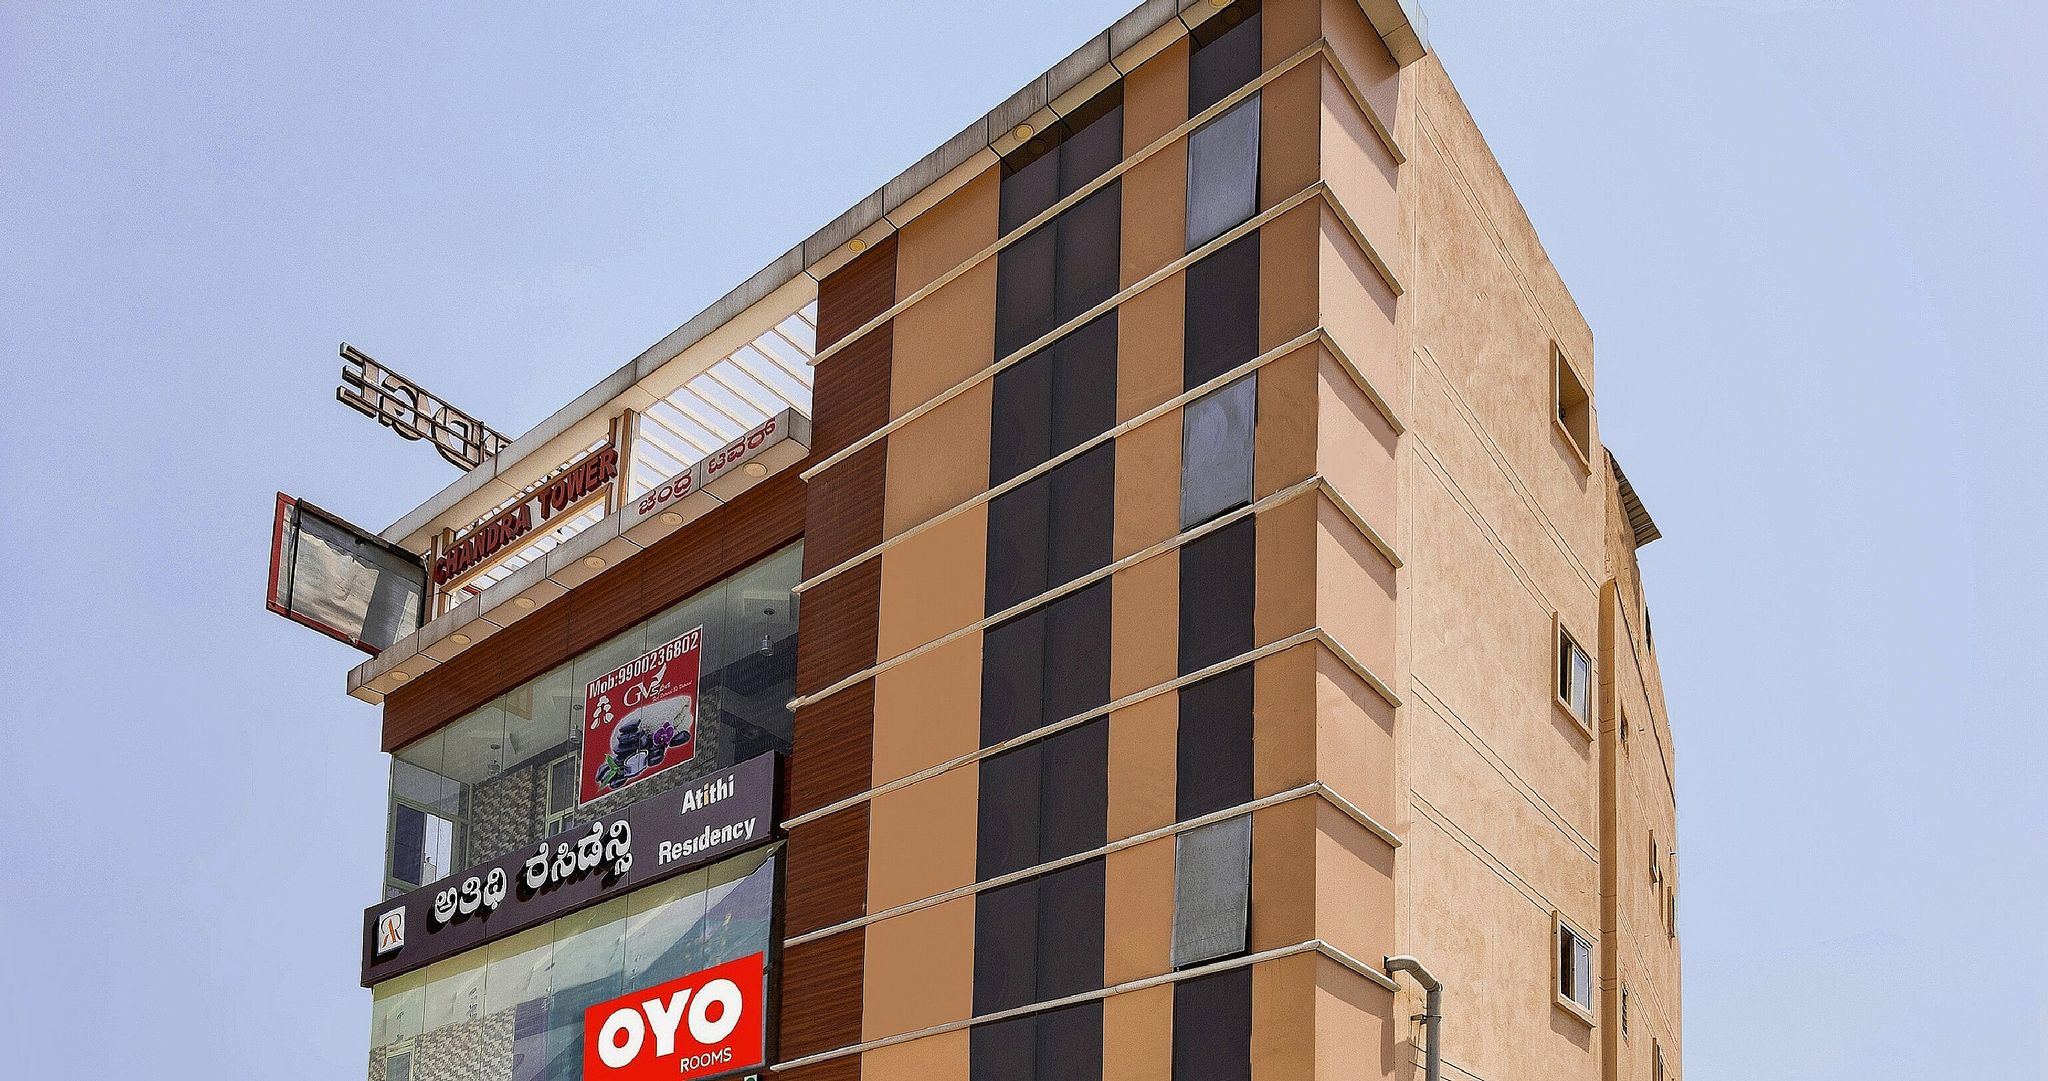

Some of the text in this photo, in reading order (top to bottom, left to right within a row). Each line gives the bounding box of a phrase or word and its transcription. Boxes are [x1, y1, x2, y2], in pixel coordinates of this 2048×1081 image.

[432, 448, 618, 585] CHANDRA TOWER
[589, 631, 699, 699] Mob:9900236802
[681, 774, 734, 814] Atithi
[526, 819, 633, 889] ರೆಸಿಡೆನ್ಸಿ
[658, 816, 756, 866] Residency
[597, 977, 743, 1069] OYO
[680, 1047, 733, 1073] ROOMS
